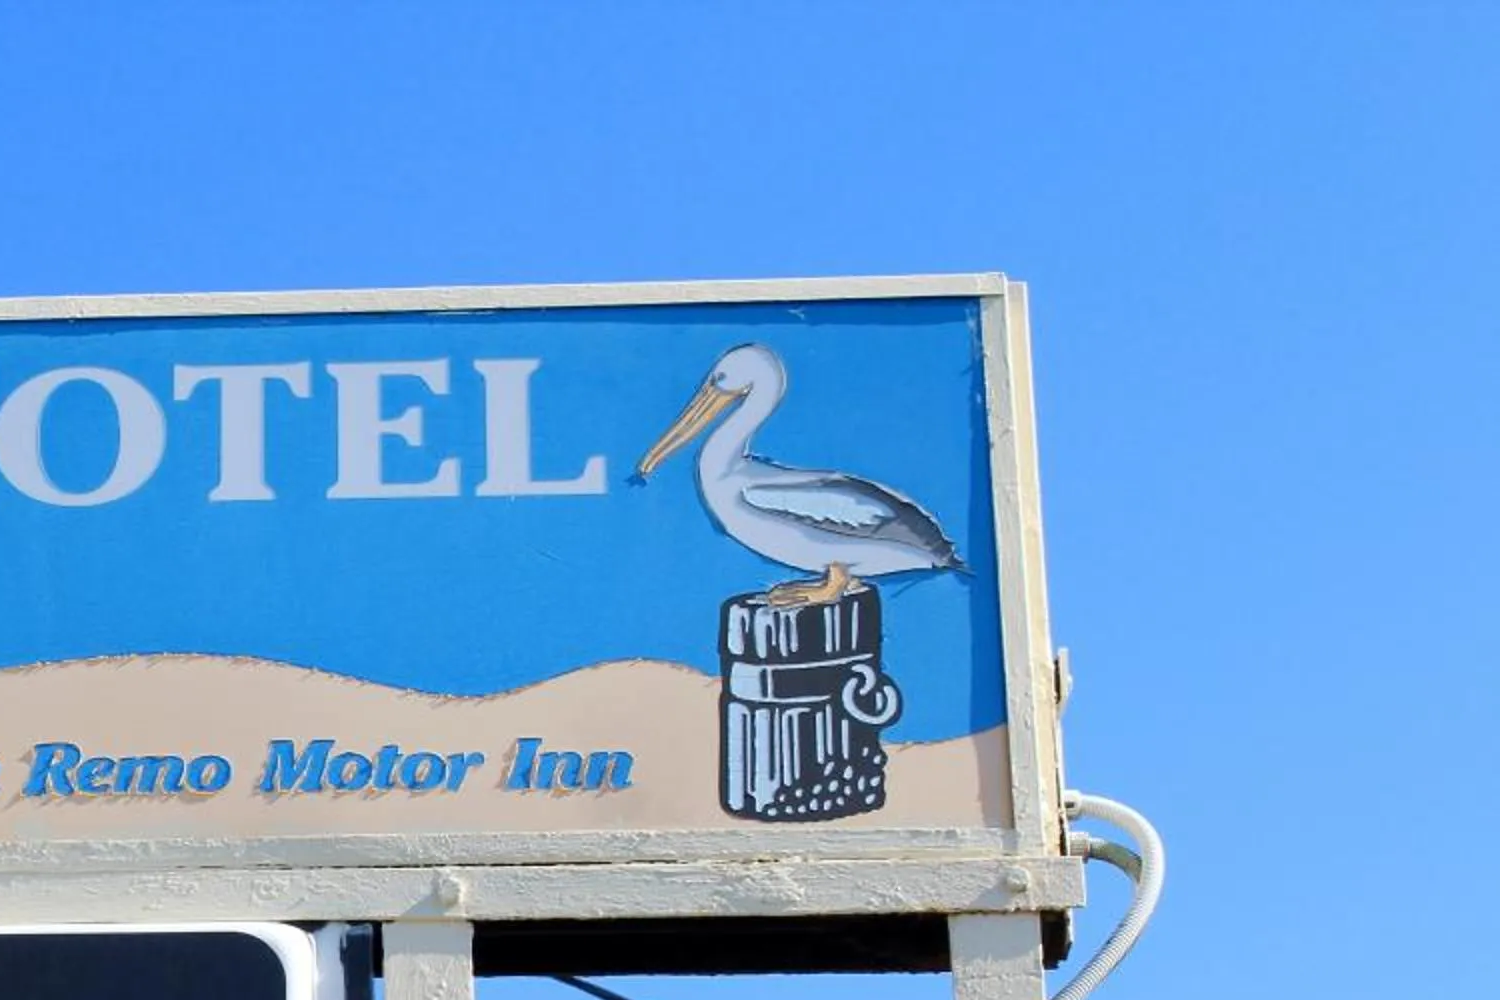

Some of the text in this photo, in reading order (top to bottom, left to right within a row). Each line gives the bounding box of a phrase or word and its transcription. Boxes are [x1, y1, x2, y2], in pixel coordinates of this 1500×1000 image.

[26, 741, 232, 794] Remo
[266, 738, 484, 790] Motor
[506, 736, 634, 787] Inn
